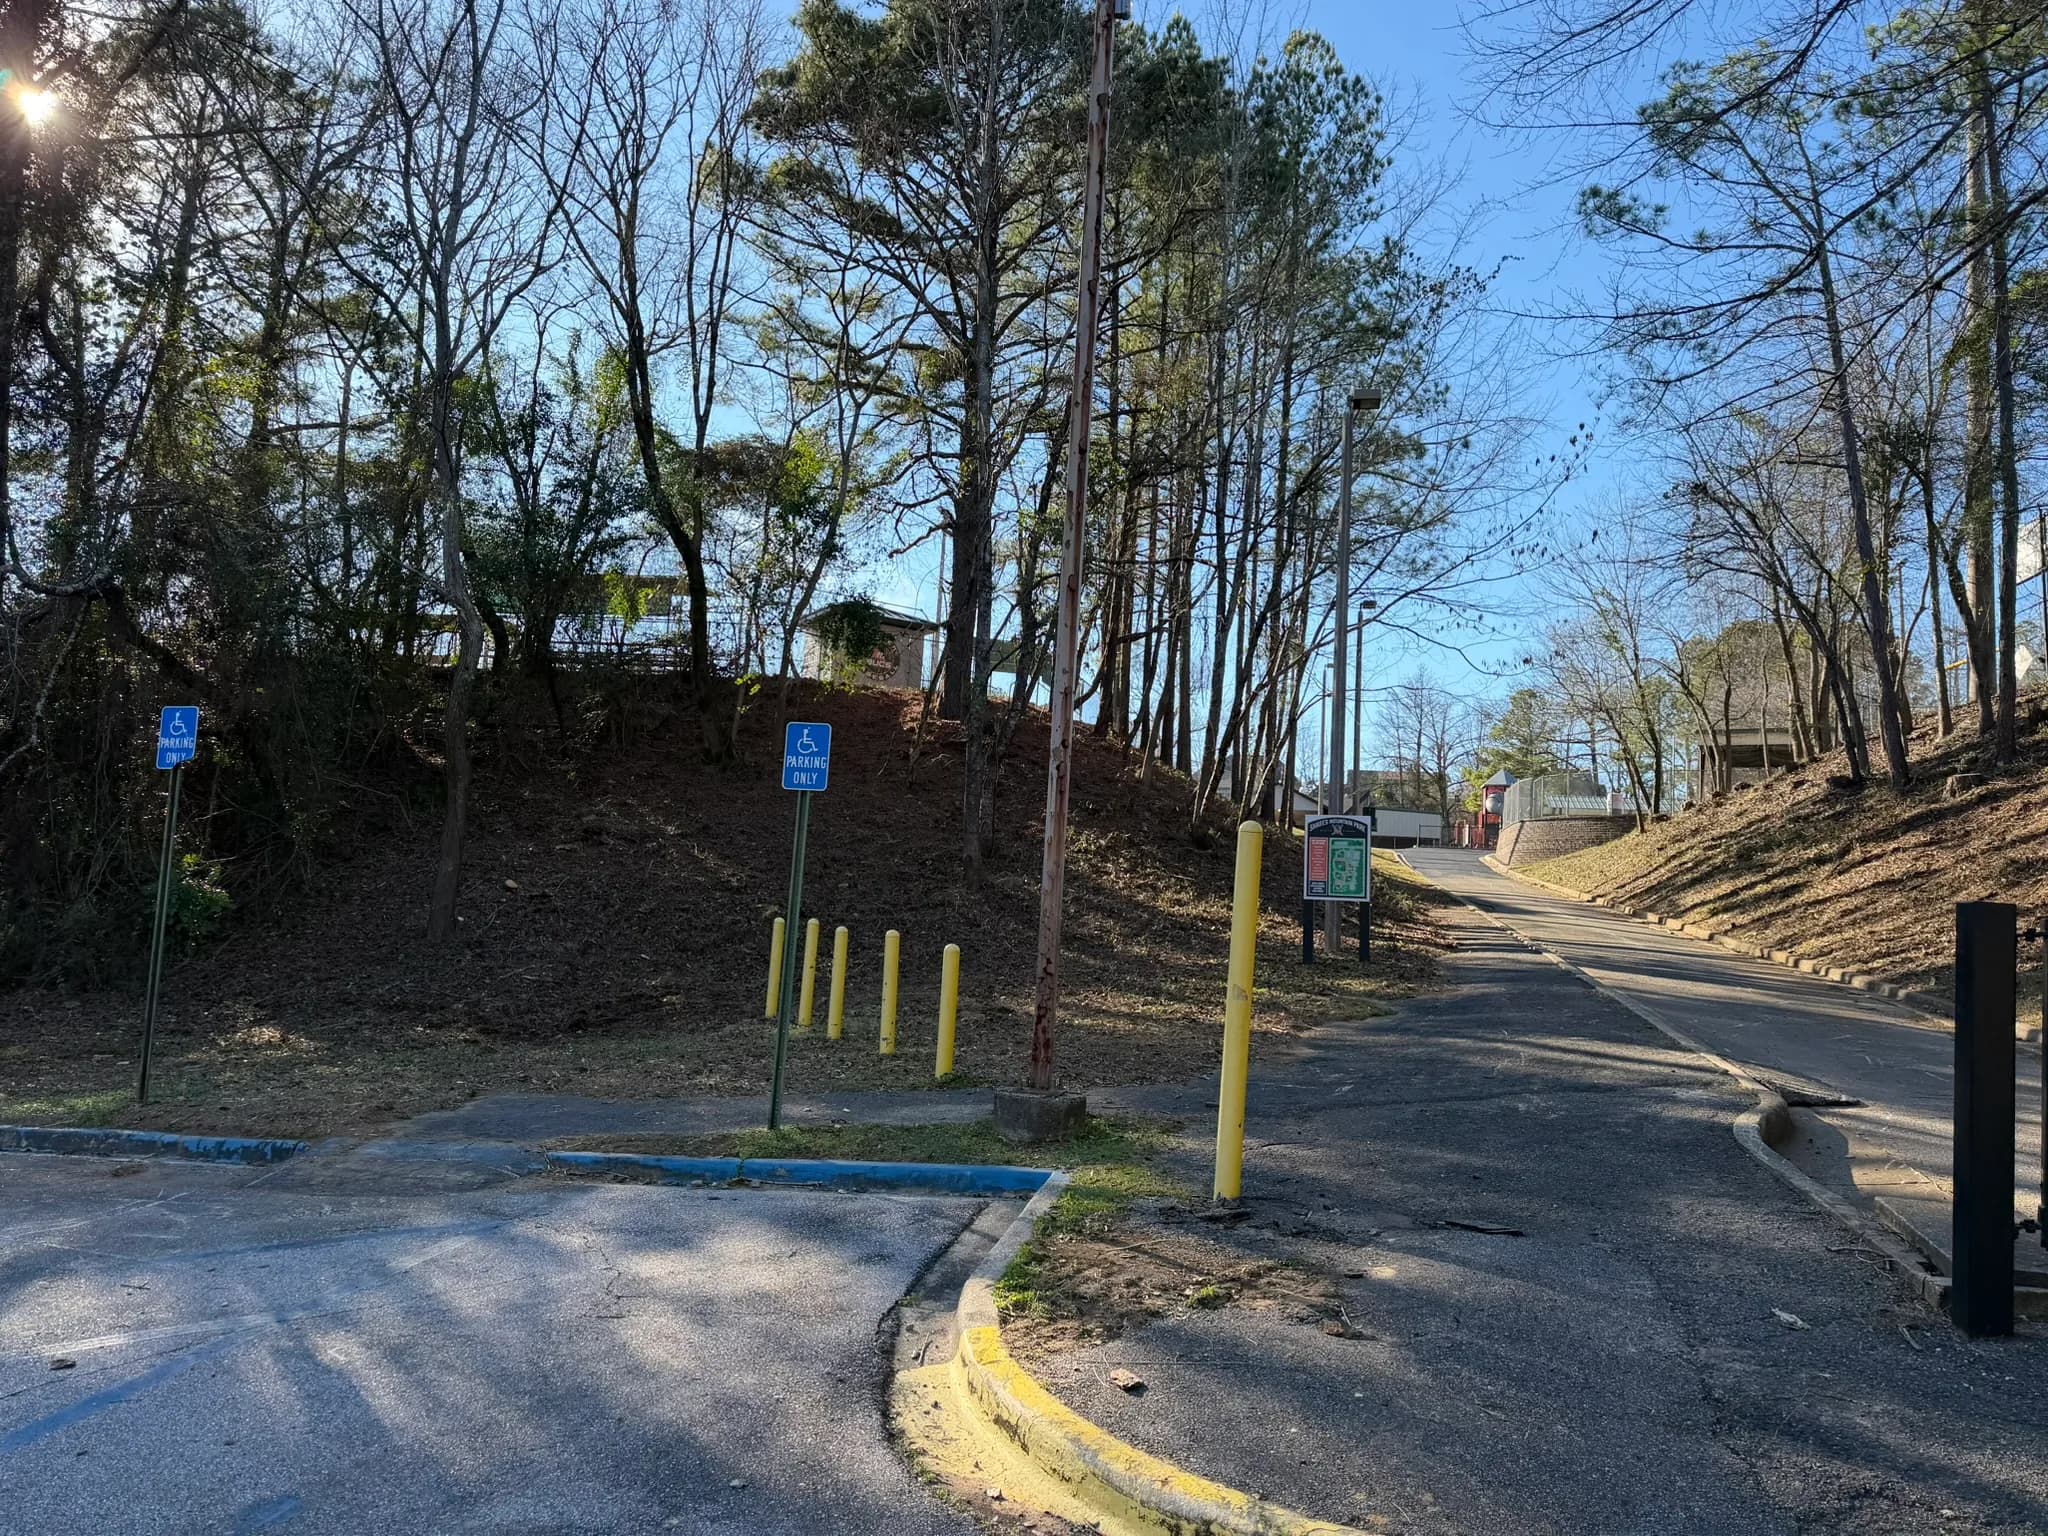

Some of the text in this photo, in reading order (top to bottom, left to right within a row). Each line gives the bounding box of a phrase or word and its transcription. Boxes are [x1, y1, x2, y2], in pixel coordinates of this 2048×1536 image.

[160, 737, 194, 749] PARKING
[166, 752, 186, 763] ONLY
[786, 755, 827, 769] PARKING
[793, 771, 818, 785] ONLY
